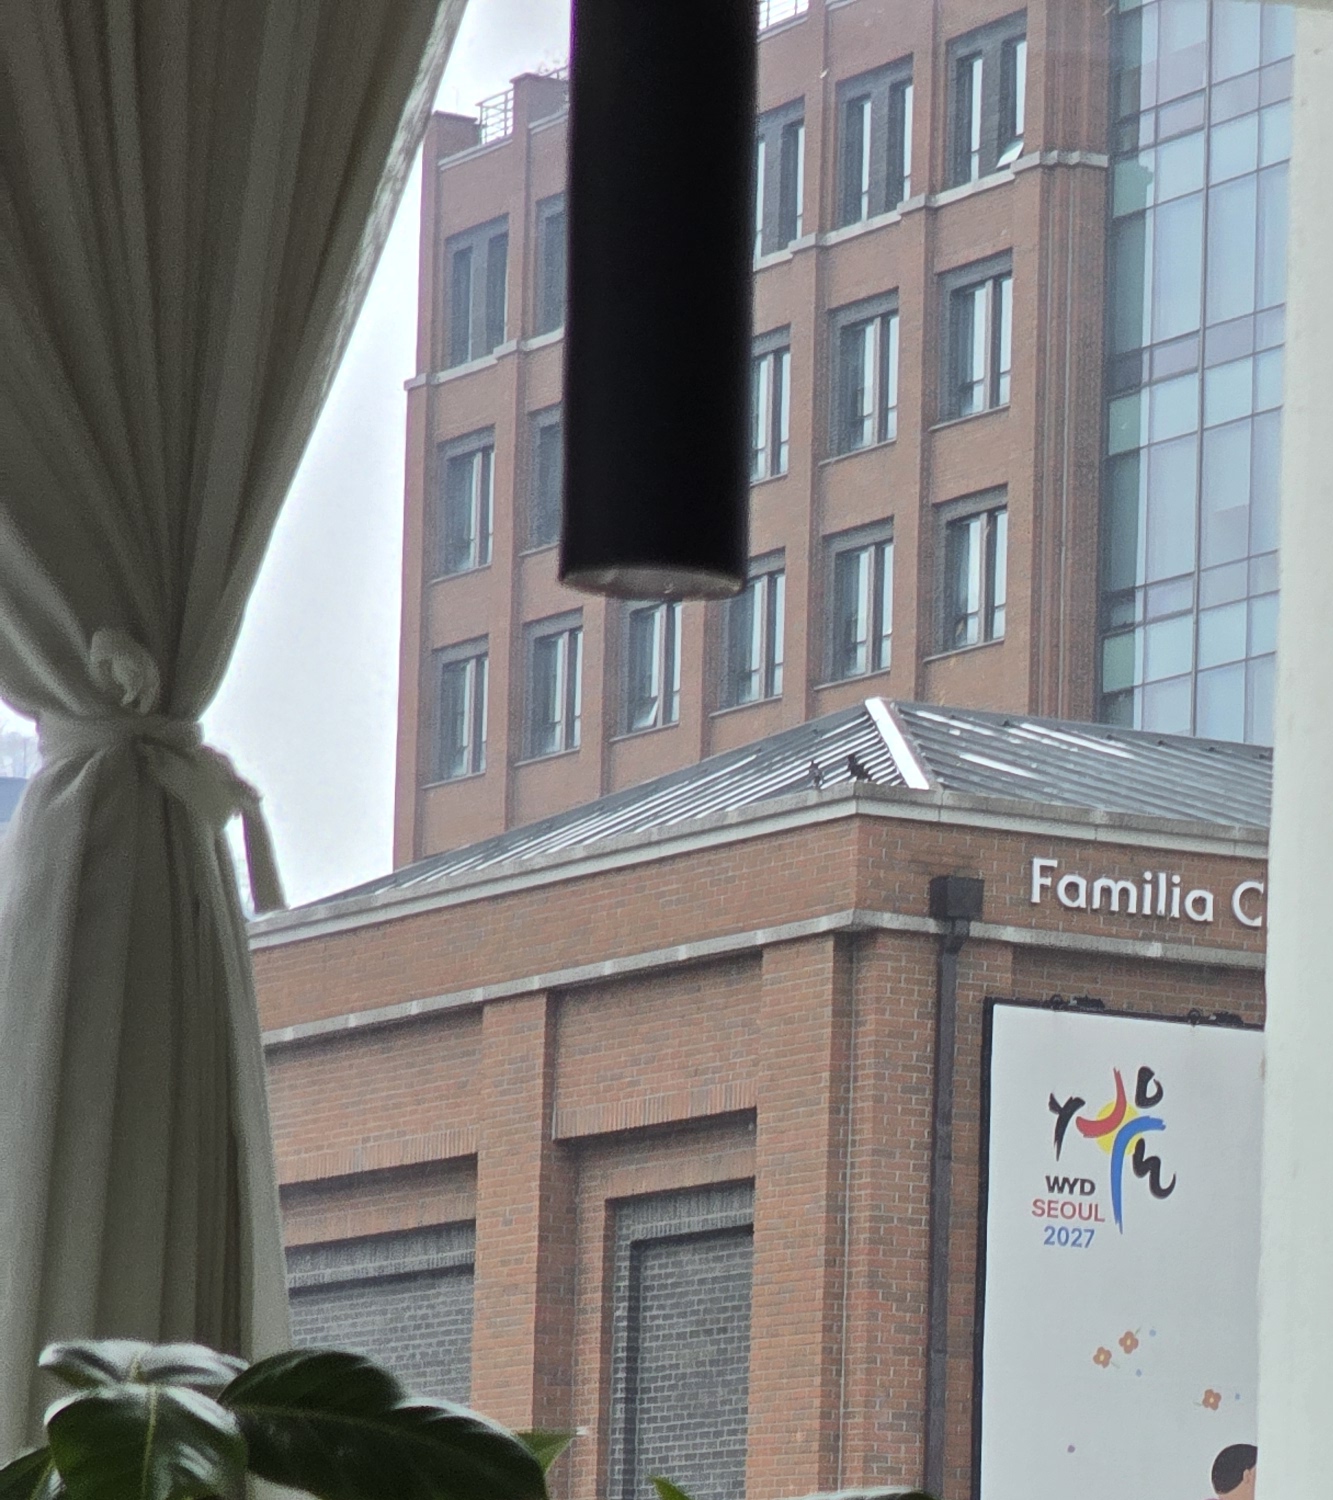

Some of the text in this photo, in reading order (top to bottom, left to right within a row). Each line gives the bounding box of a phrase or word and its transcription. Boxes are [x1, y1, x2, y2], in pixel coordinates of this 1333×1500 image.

[1030, 857, 1215, 923] Familia
[1045, 1175, 1096, 1197] WYD
[1031, 1197, 1106, 1224] SEOUL
[1042, 1225, 1096, 1249] 2027
